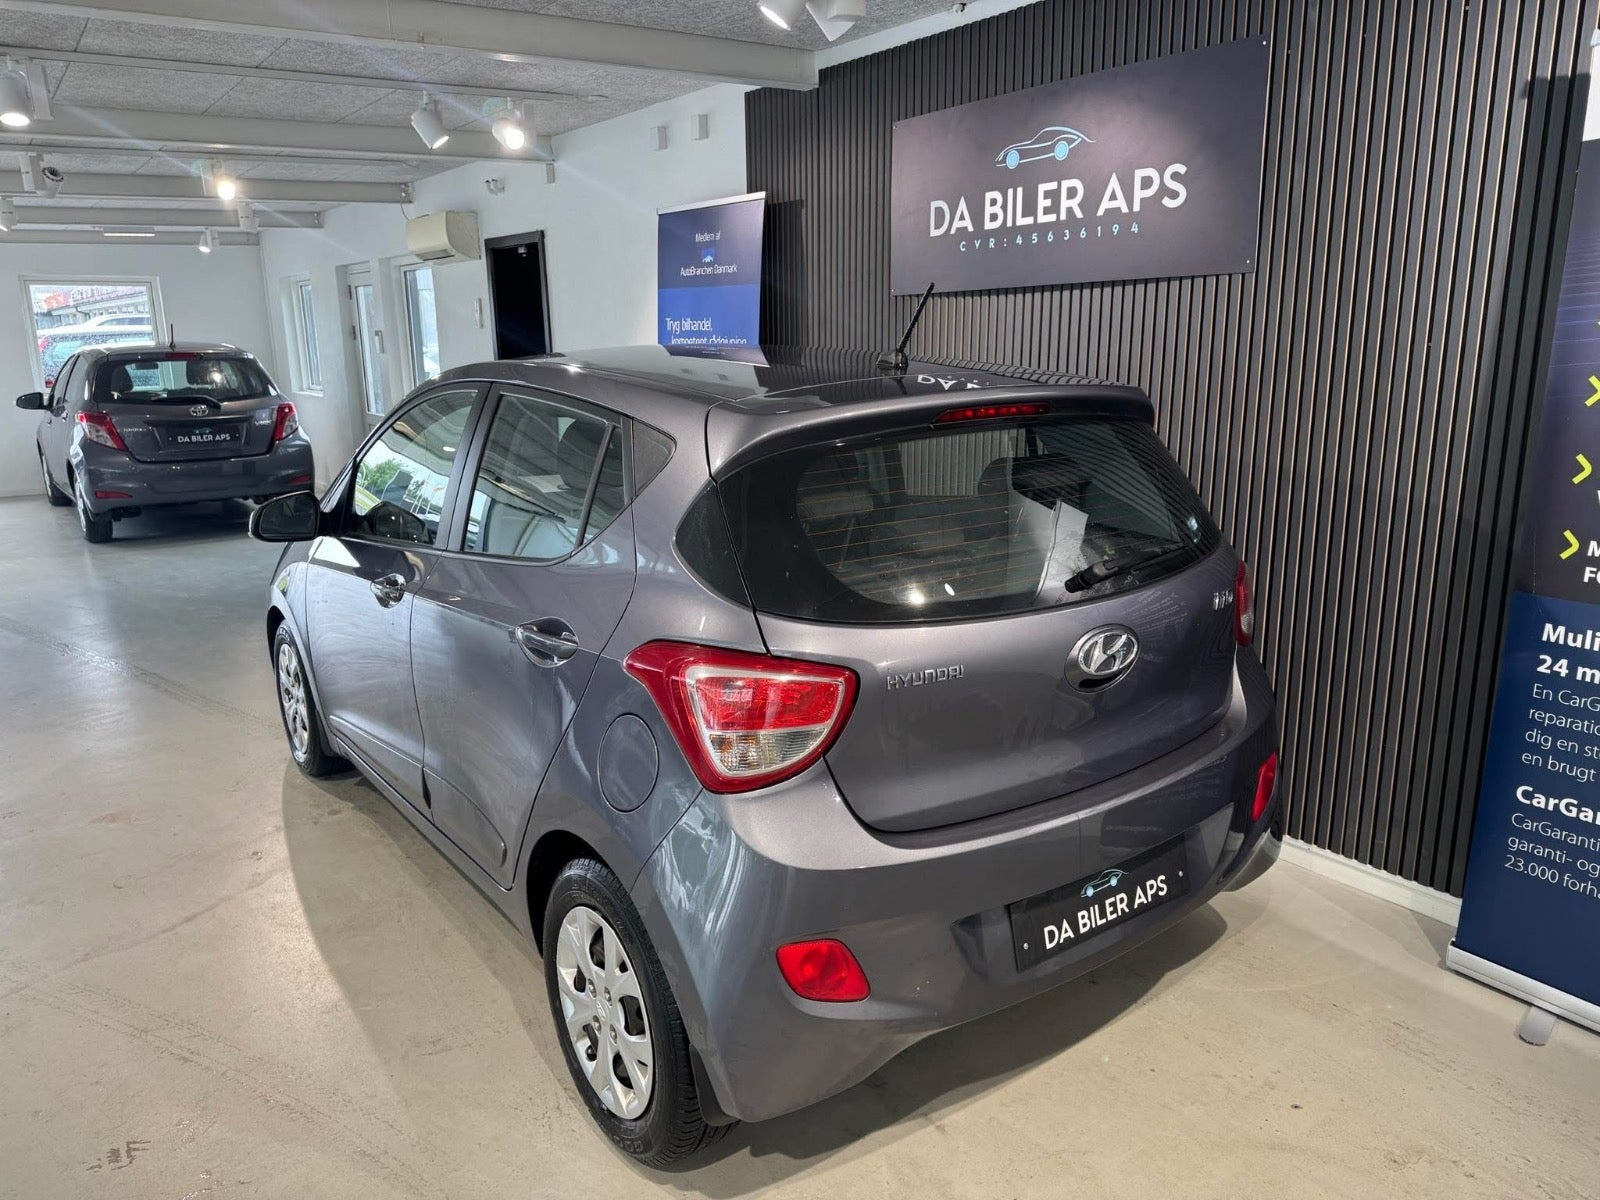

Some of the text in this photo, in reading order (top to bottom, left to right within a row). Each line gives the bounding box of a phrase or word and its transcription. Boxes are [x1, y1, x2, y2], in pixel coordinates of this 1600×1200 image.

[929, 163, 1188, 237] DA BILER APS
[680, 264, 738, 276] AutoBranchen Danmark
[665, 317, 681, 334] Tryg
[177, 433, 231, 443] DA BILER APS
[886, 664, 964, 690] HYUNDAI
[1536, 654, 1569, 678] 24
[1532, 683, 1600, 712] En CarG
[1525, 728, 1600, 760] dig en st
[1521, 752, 1596, 783] en brugt
[1507, 836, 1600, 878] garanti- og
[1504, 854, 1600, 899] 23.000 forh
[1043, 874, 1168, 950] DA BILER APS
